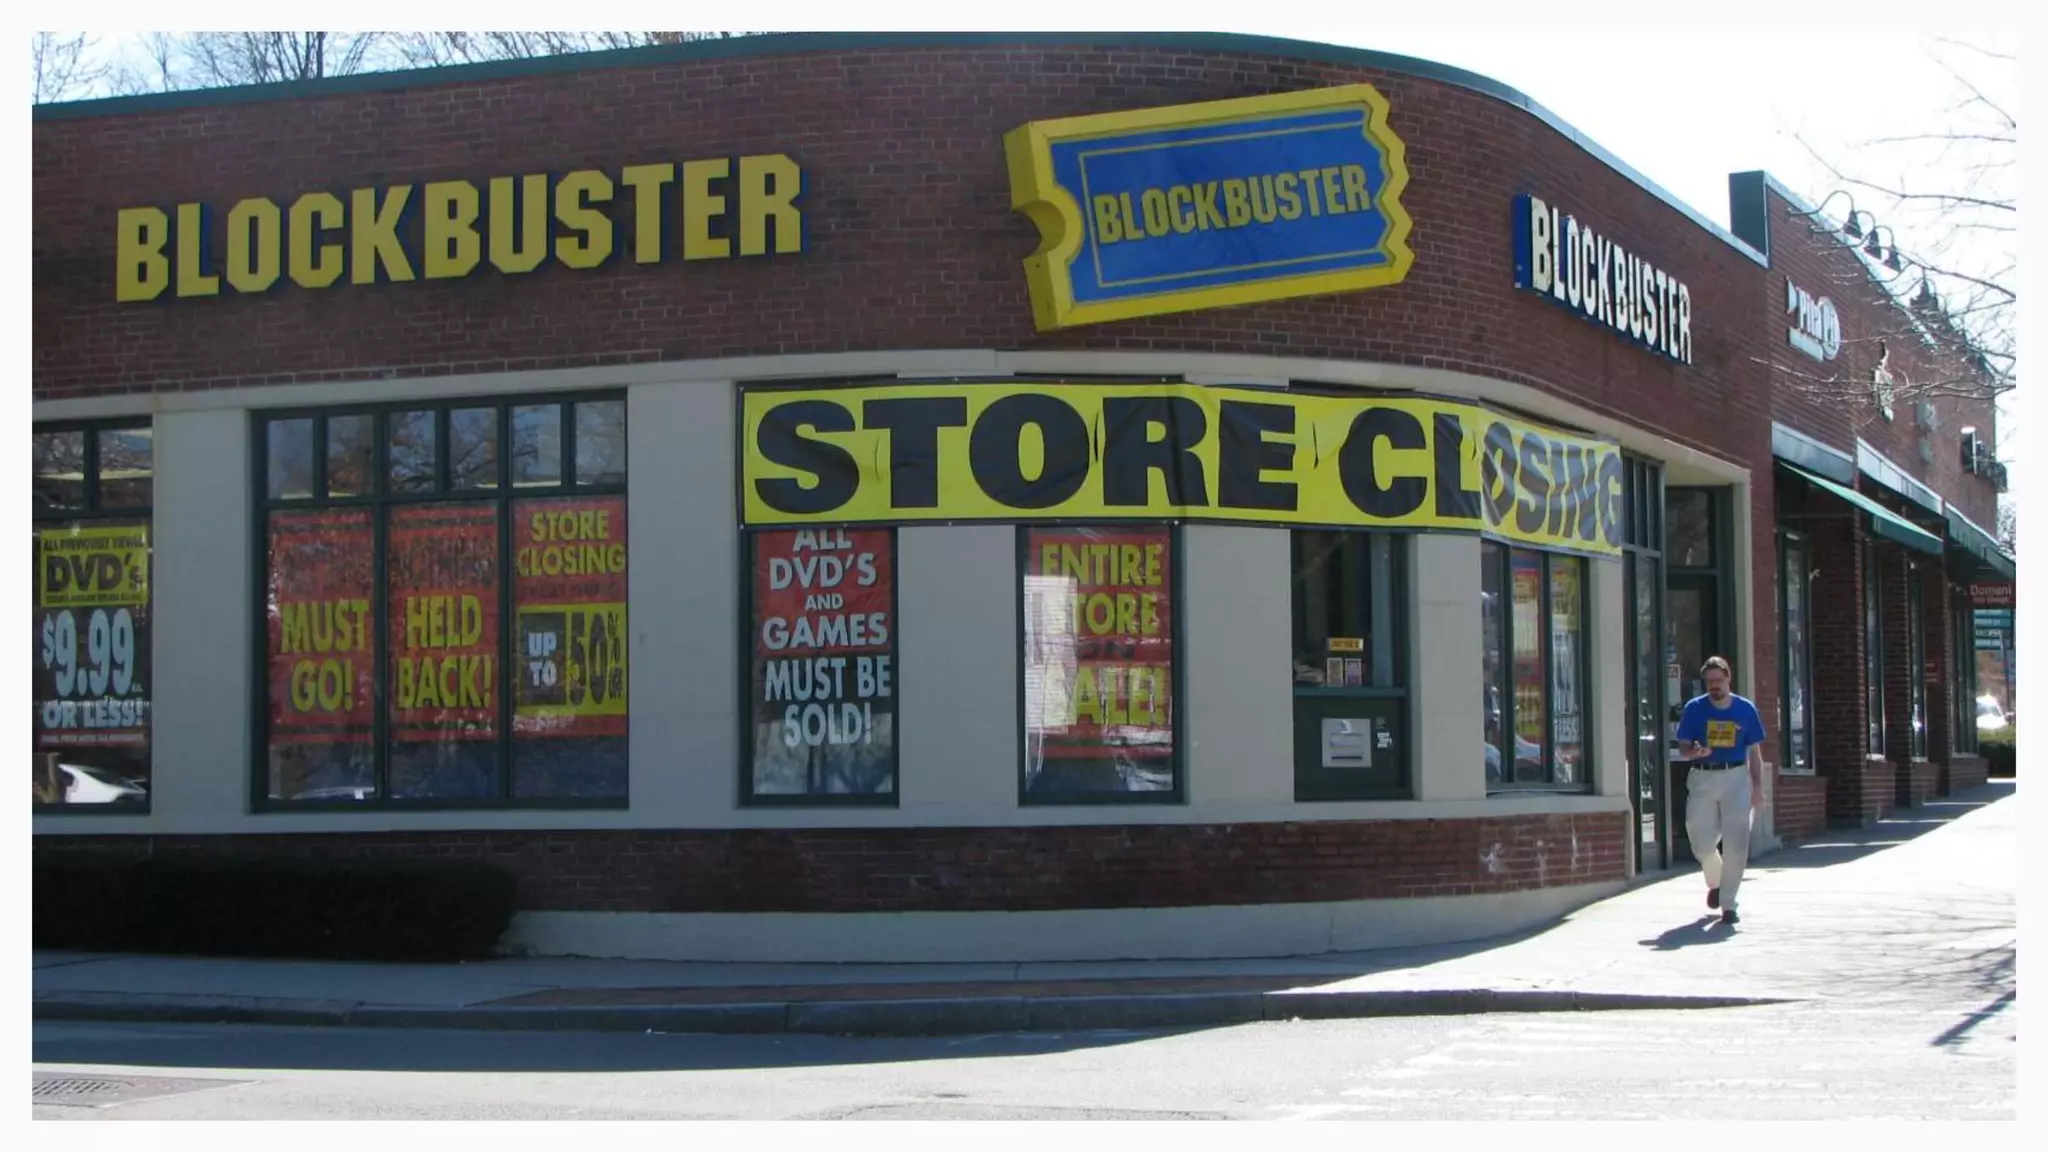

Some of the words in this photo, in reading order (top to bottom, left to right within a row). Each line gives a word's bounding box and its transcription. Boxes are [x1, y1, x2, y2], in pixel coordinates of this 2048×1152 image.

[1094, 164, 1371, 245] BLOCKBUSTER
[116, 153, 802, 303] BLOCKBUSTER
[1531, 195, 1692, 364] BLOCKBUSTER
[754, 393, 1299, 514] STORE
[1338, 407, 1622, 548] CLOSING
[531, 509, 608, 541] STORE
[792, 530, 852, 552] ALL
[46, 552, 142, 593] DVD's
[516, 543, 626, 577] CLOSING
[769, 553, 877, 591] DVD'S
[1041, 542, 1163, 587] ENTIRE
[405, 594, 483, 649] HELD
[805, 594, 844, 611] AND
[280, 598, 370, 653] MUST
[528, 632, 557, 656] UP
[762, 612, 888, 650] GAMES
[42, 607, 135, 697] $9.99
[530, 660, 557, 686] TO
[291, 657, 354, 713] GO!
[396, 654, 493, 711] BACK!
[764, 656, 847, 702] MUST
[857, 655, 892, 698] BE
[43, 699, 77, 729] OR
[82, 697, 144, 728] LESS!
[784, 702, 872, 748] SOLD!
